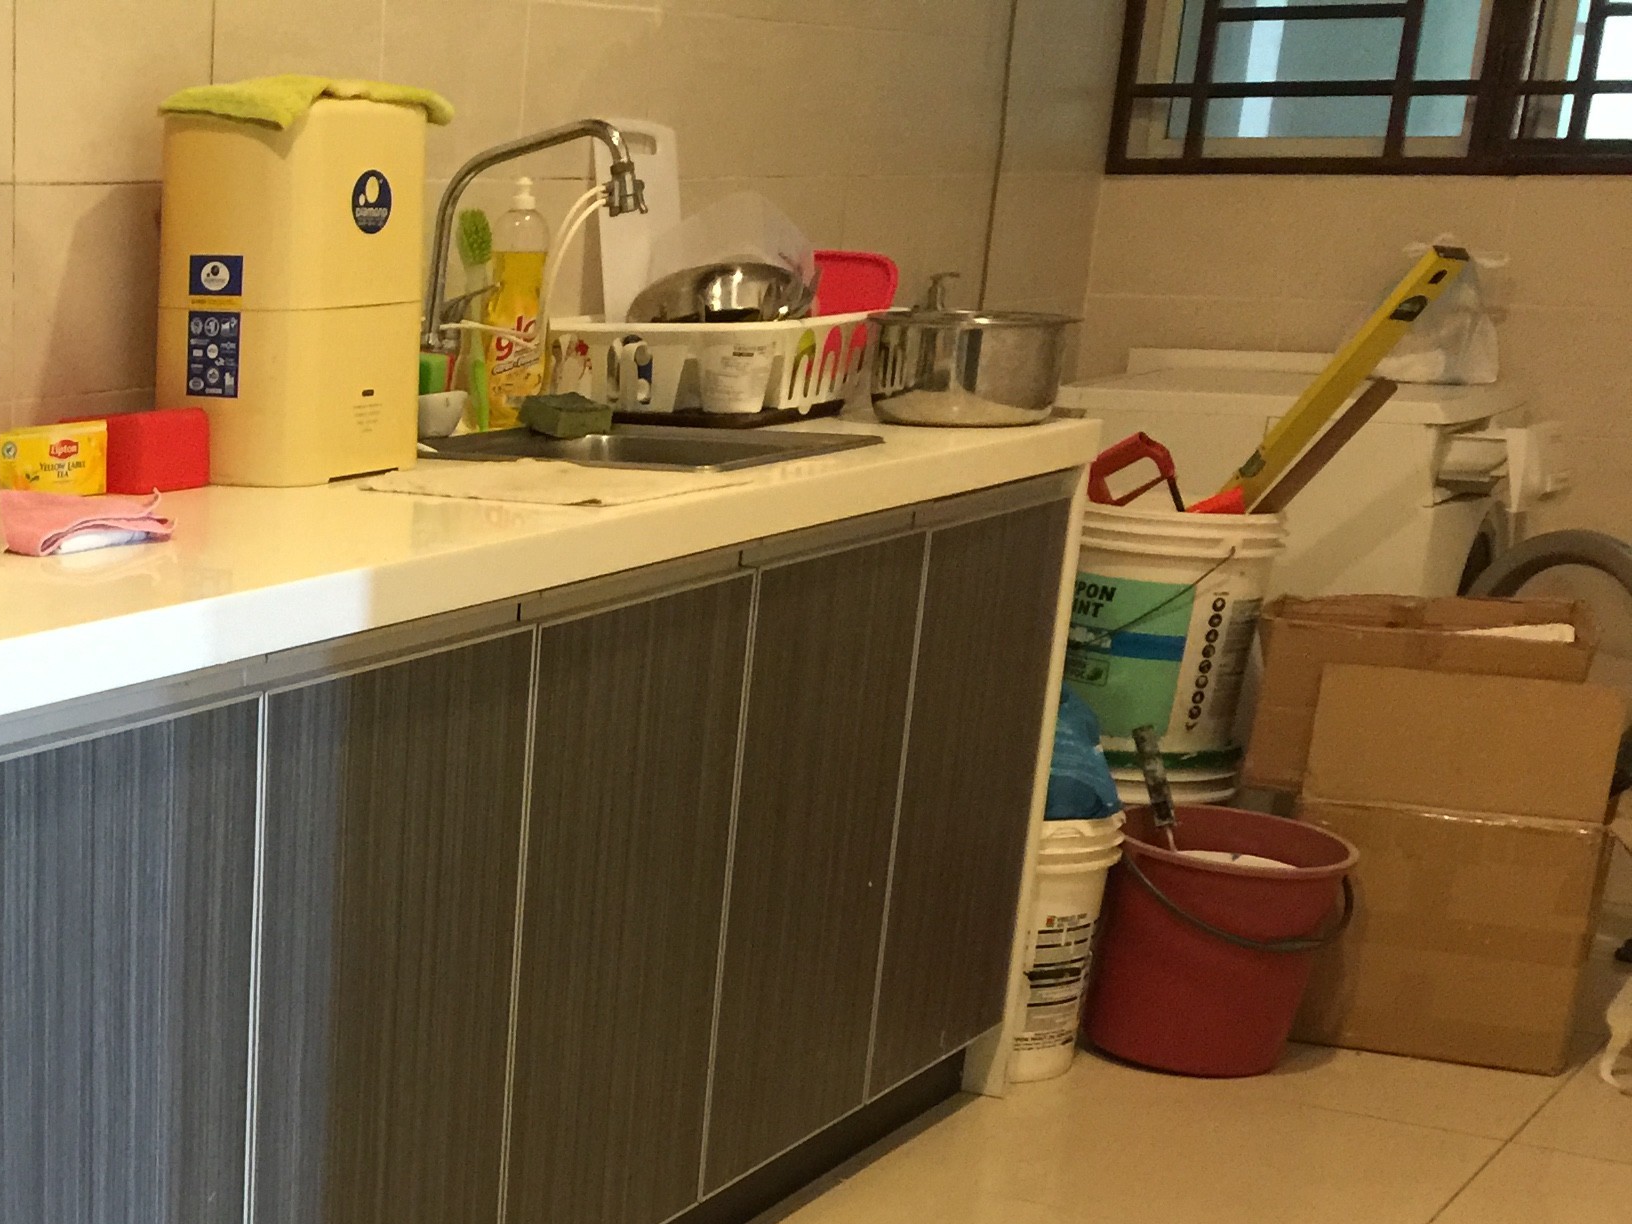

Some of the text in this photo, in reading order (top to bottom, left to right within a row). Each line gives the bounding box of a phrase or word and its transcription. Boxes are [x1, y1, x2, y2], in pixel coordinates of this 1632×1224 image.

[51, 444, 77, 457] Lipton
[40, 460, 86, 472] YELLOW LABEL
[57, 470, 69, 478] TEA
